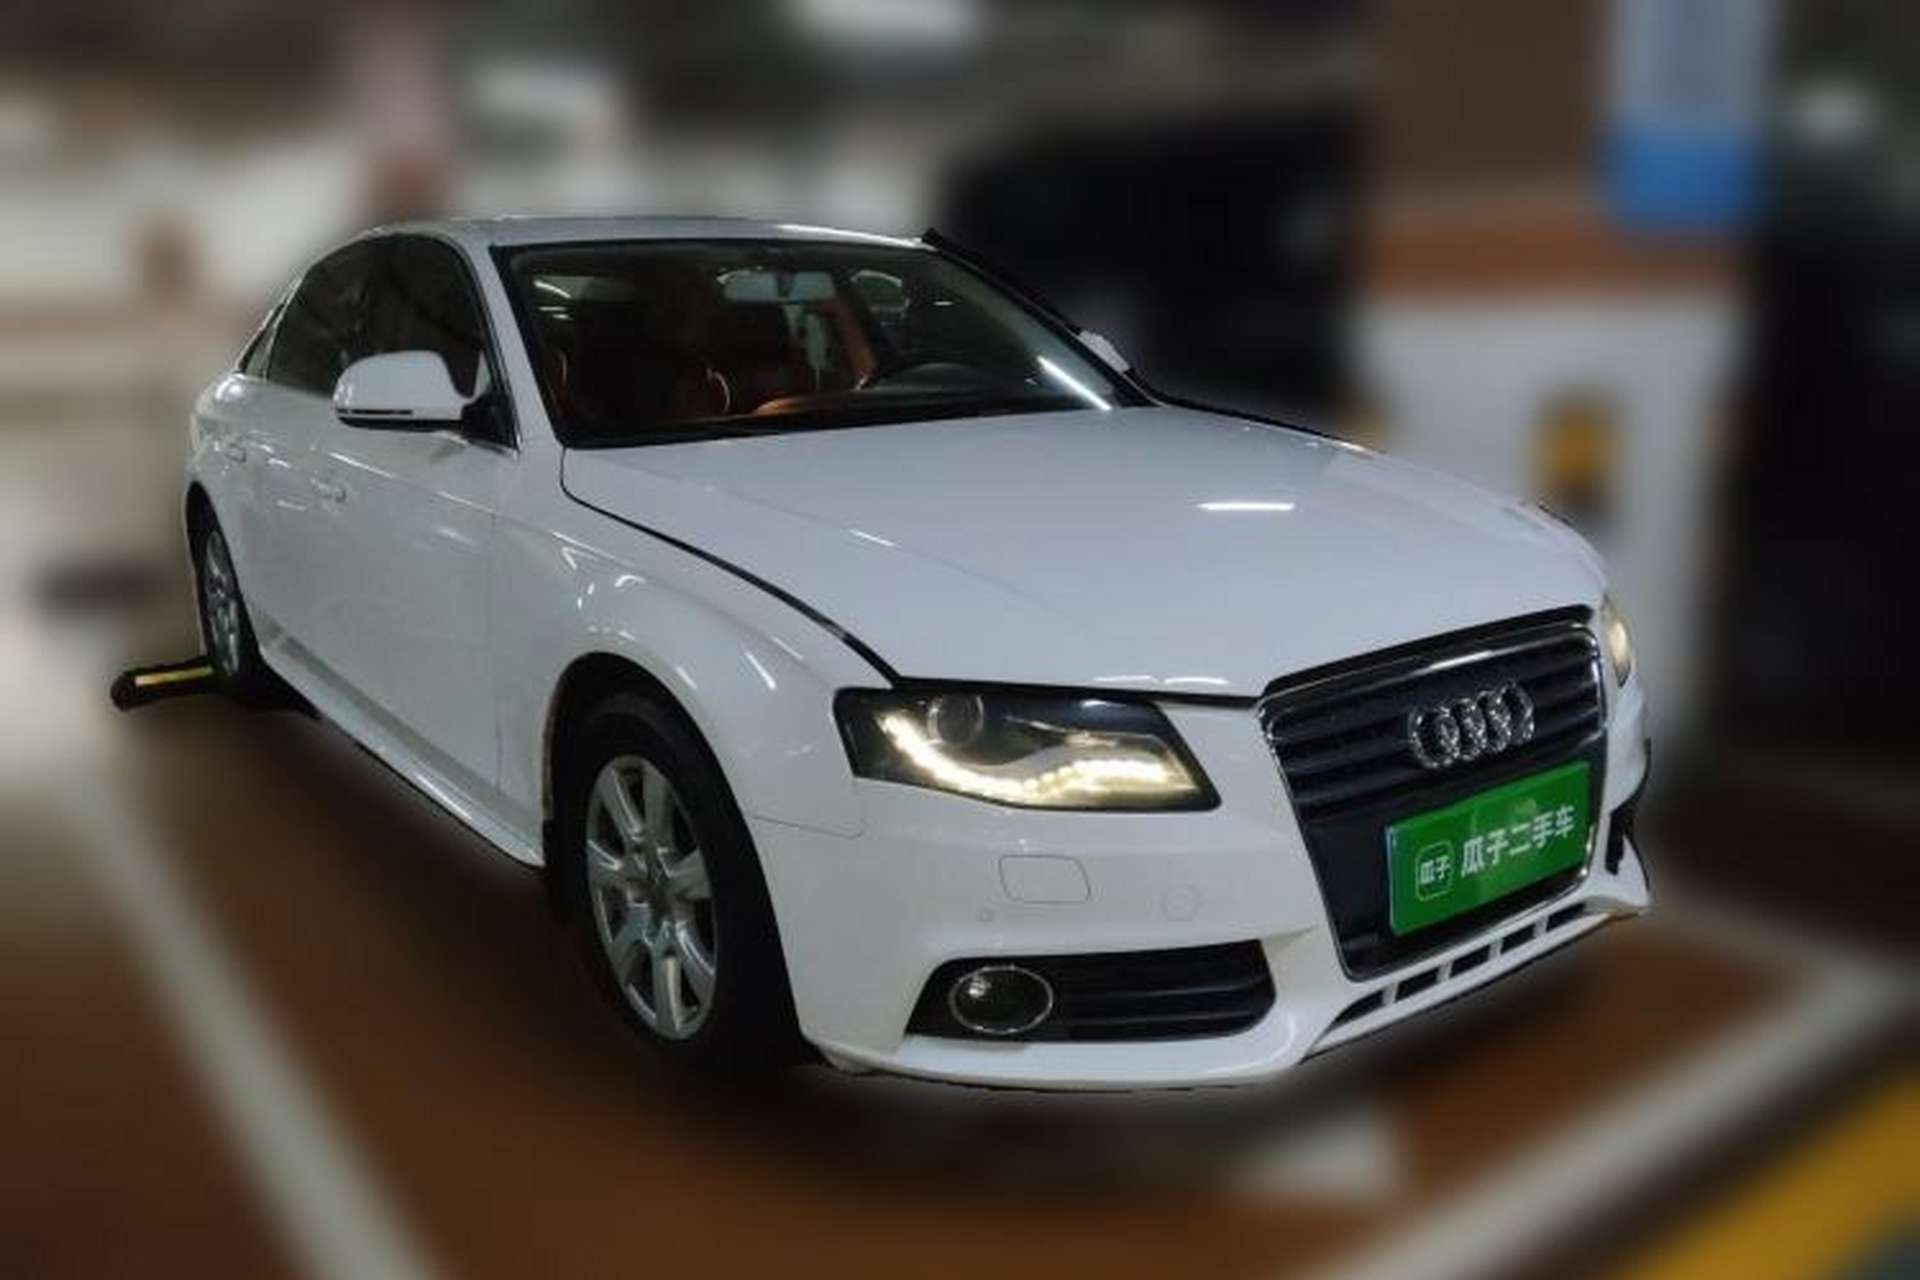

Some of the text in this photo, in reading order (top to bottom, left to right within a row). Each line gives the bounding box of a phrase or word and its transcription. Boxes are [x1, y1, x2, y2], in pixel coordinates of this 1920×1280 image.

[1461, 805, 1575, 877] 瓜子二手车
[1419, 854, 1450, 885] 瓜子
